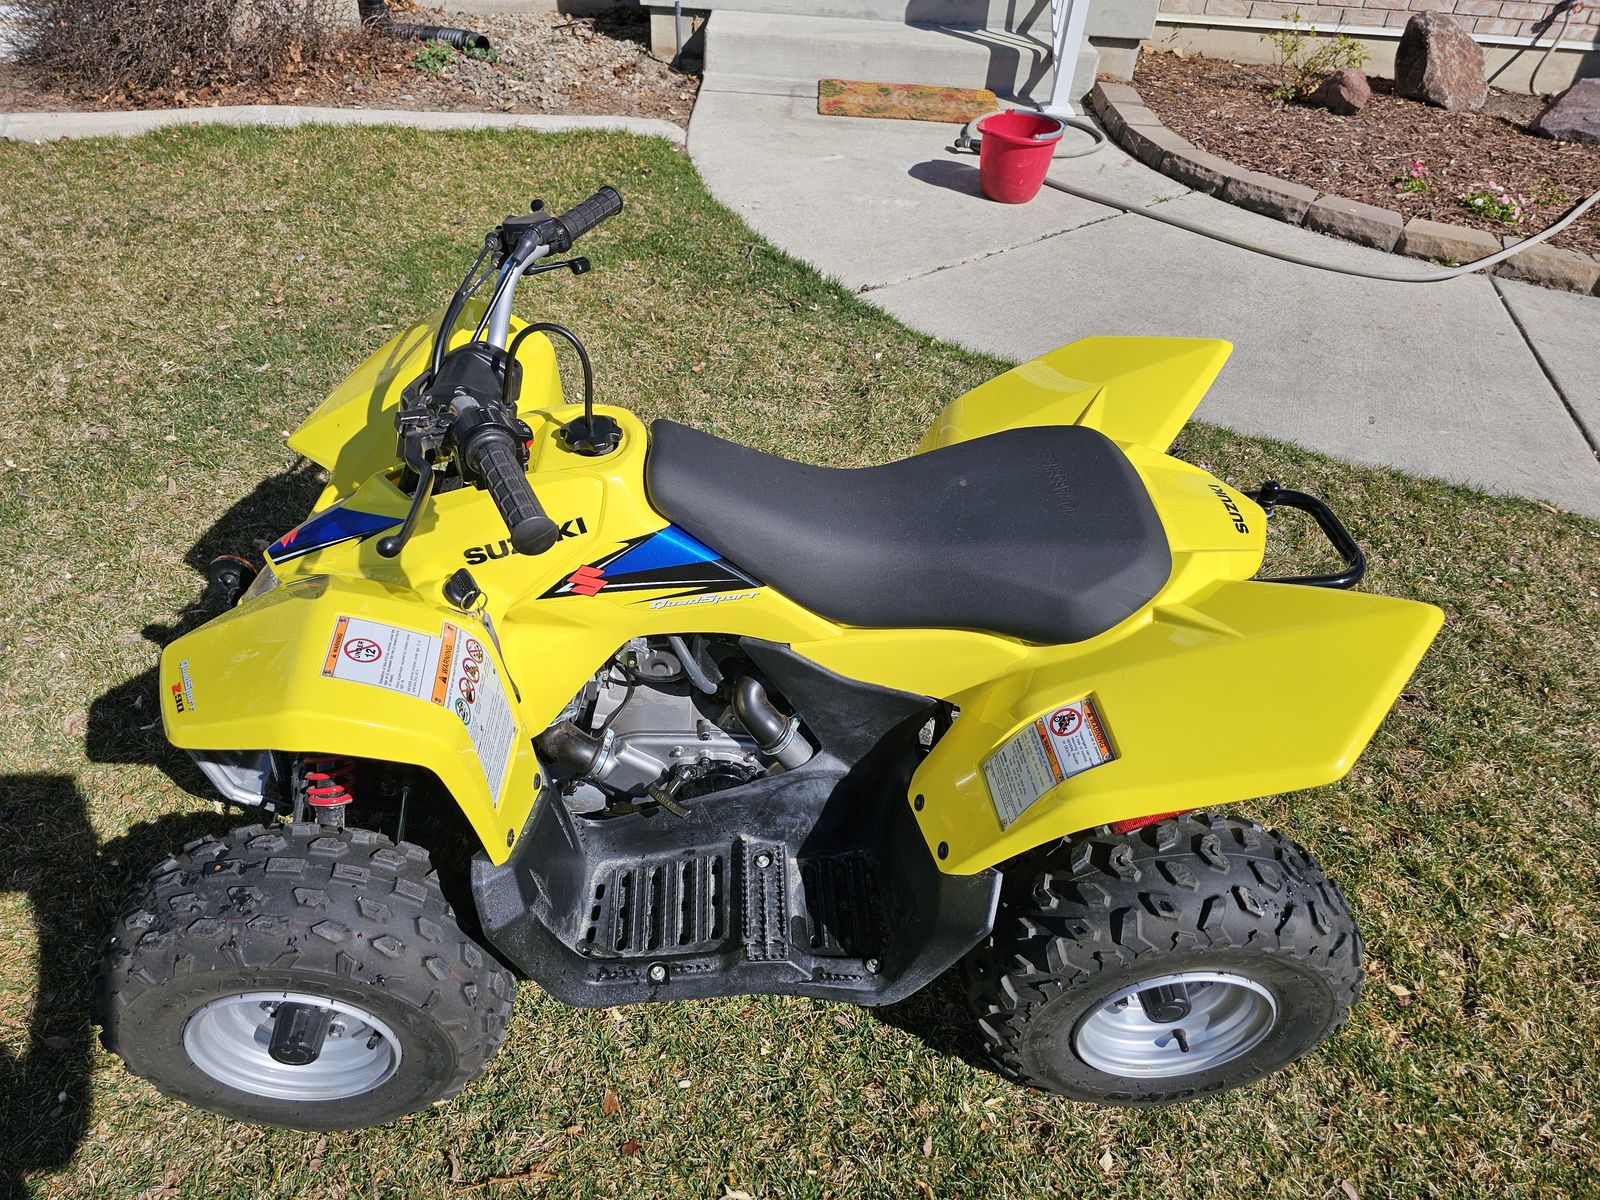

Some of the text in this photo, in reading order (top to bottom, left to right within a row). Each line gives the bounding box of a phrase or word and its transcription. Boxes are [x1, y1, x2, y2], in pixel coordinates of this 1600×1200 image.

[1208, 483, 1249, 534] SUZUKI
[463, 517, 588, 566] SUKI
[649, 591, 761, 610] QuadSport
[334, 633, 343, 655] WARNING
[354, 640, 365, 659] UNDER
[364, 648, 376, 658] 12
[442, 645, 453, 674] WARNING
[1089, 717, 1106, 749] WARNING
